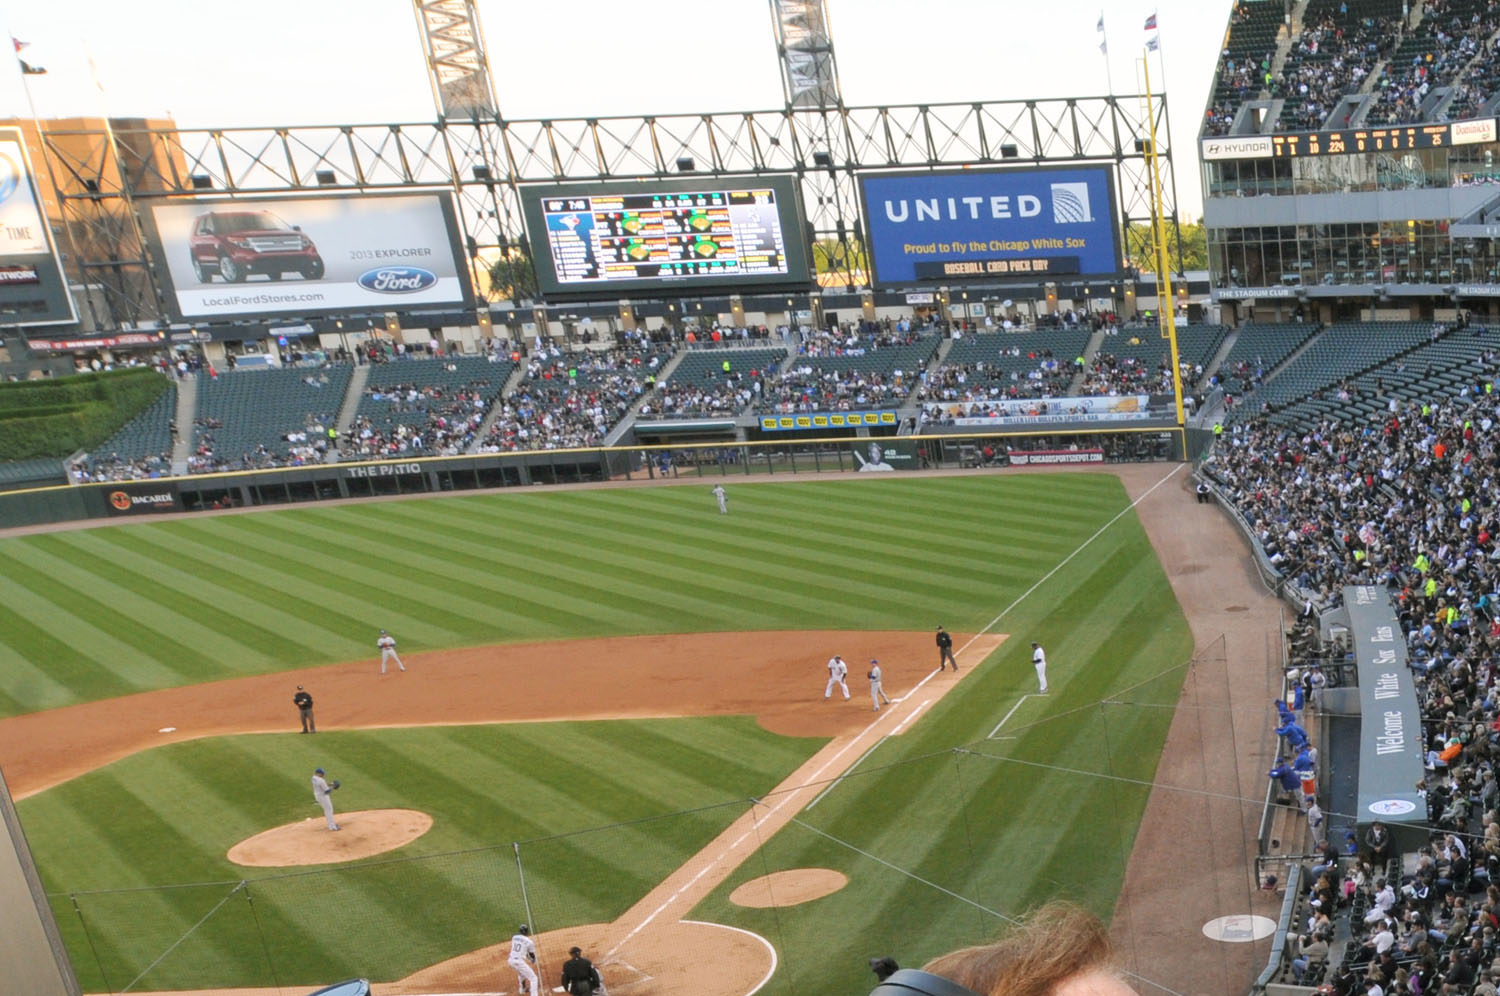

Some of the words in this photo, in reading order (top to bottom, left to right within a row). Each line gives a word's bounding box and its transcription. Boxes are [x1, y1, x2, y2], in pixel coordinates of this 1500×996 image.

[1224, 143, 1269, 153] HYUNDAI
[884, 194, 1042, 222] UNITED
[350, 251, 373, 260] 2013
[375, 247, 431, 259] EXPLORER
[903, 241, 937, 254] Proud
[938, 242, 950, 253] to
[952, 241, 967, 254] fly
[969, 240, 987, 252] the
[989, 238, 1030, 252] Chicago
[1031, 237, 1063, 249] White
[1065, 237, 1086, 248] Sox
[944, 262, 986, 275] BASEBALL
[373, 270, 422, 290] Ford
[202, 291, 325, 307] LocalFordStores.com
[1234, 289, 1268, 298] STADIUM
[1269, 289, 1288, 297] CLUB
[347, 466, 377, 477] THE
[380, 463, 421, 476] PATIO
[1371, 626, 1394, 643] Fans
[1373, 649, 1397, 664] Sox
[1374, 672, 1400, 701] White
[1376, 711, 1405, 755] Welcome
